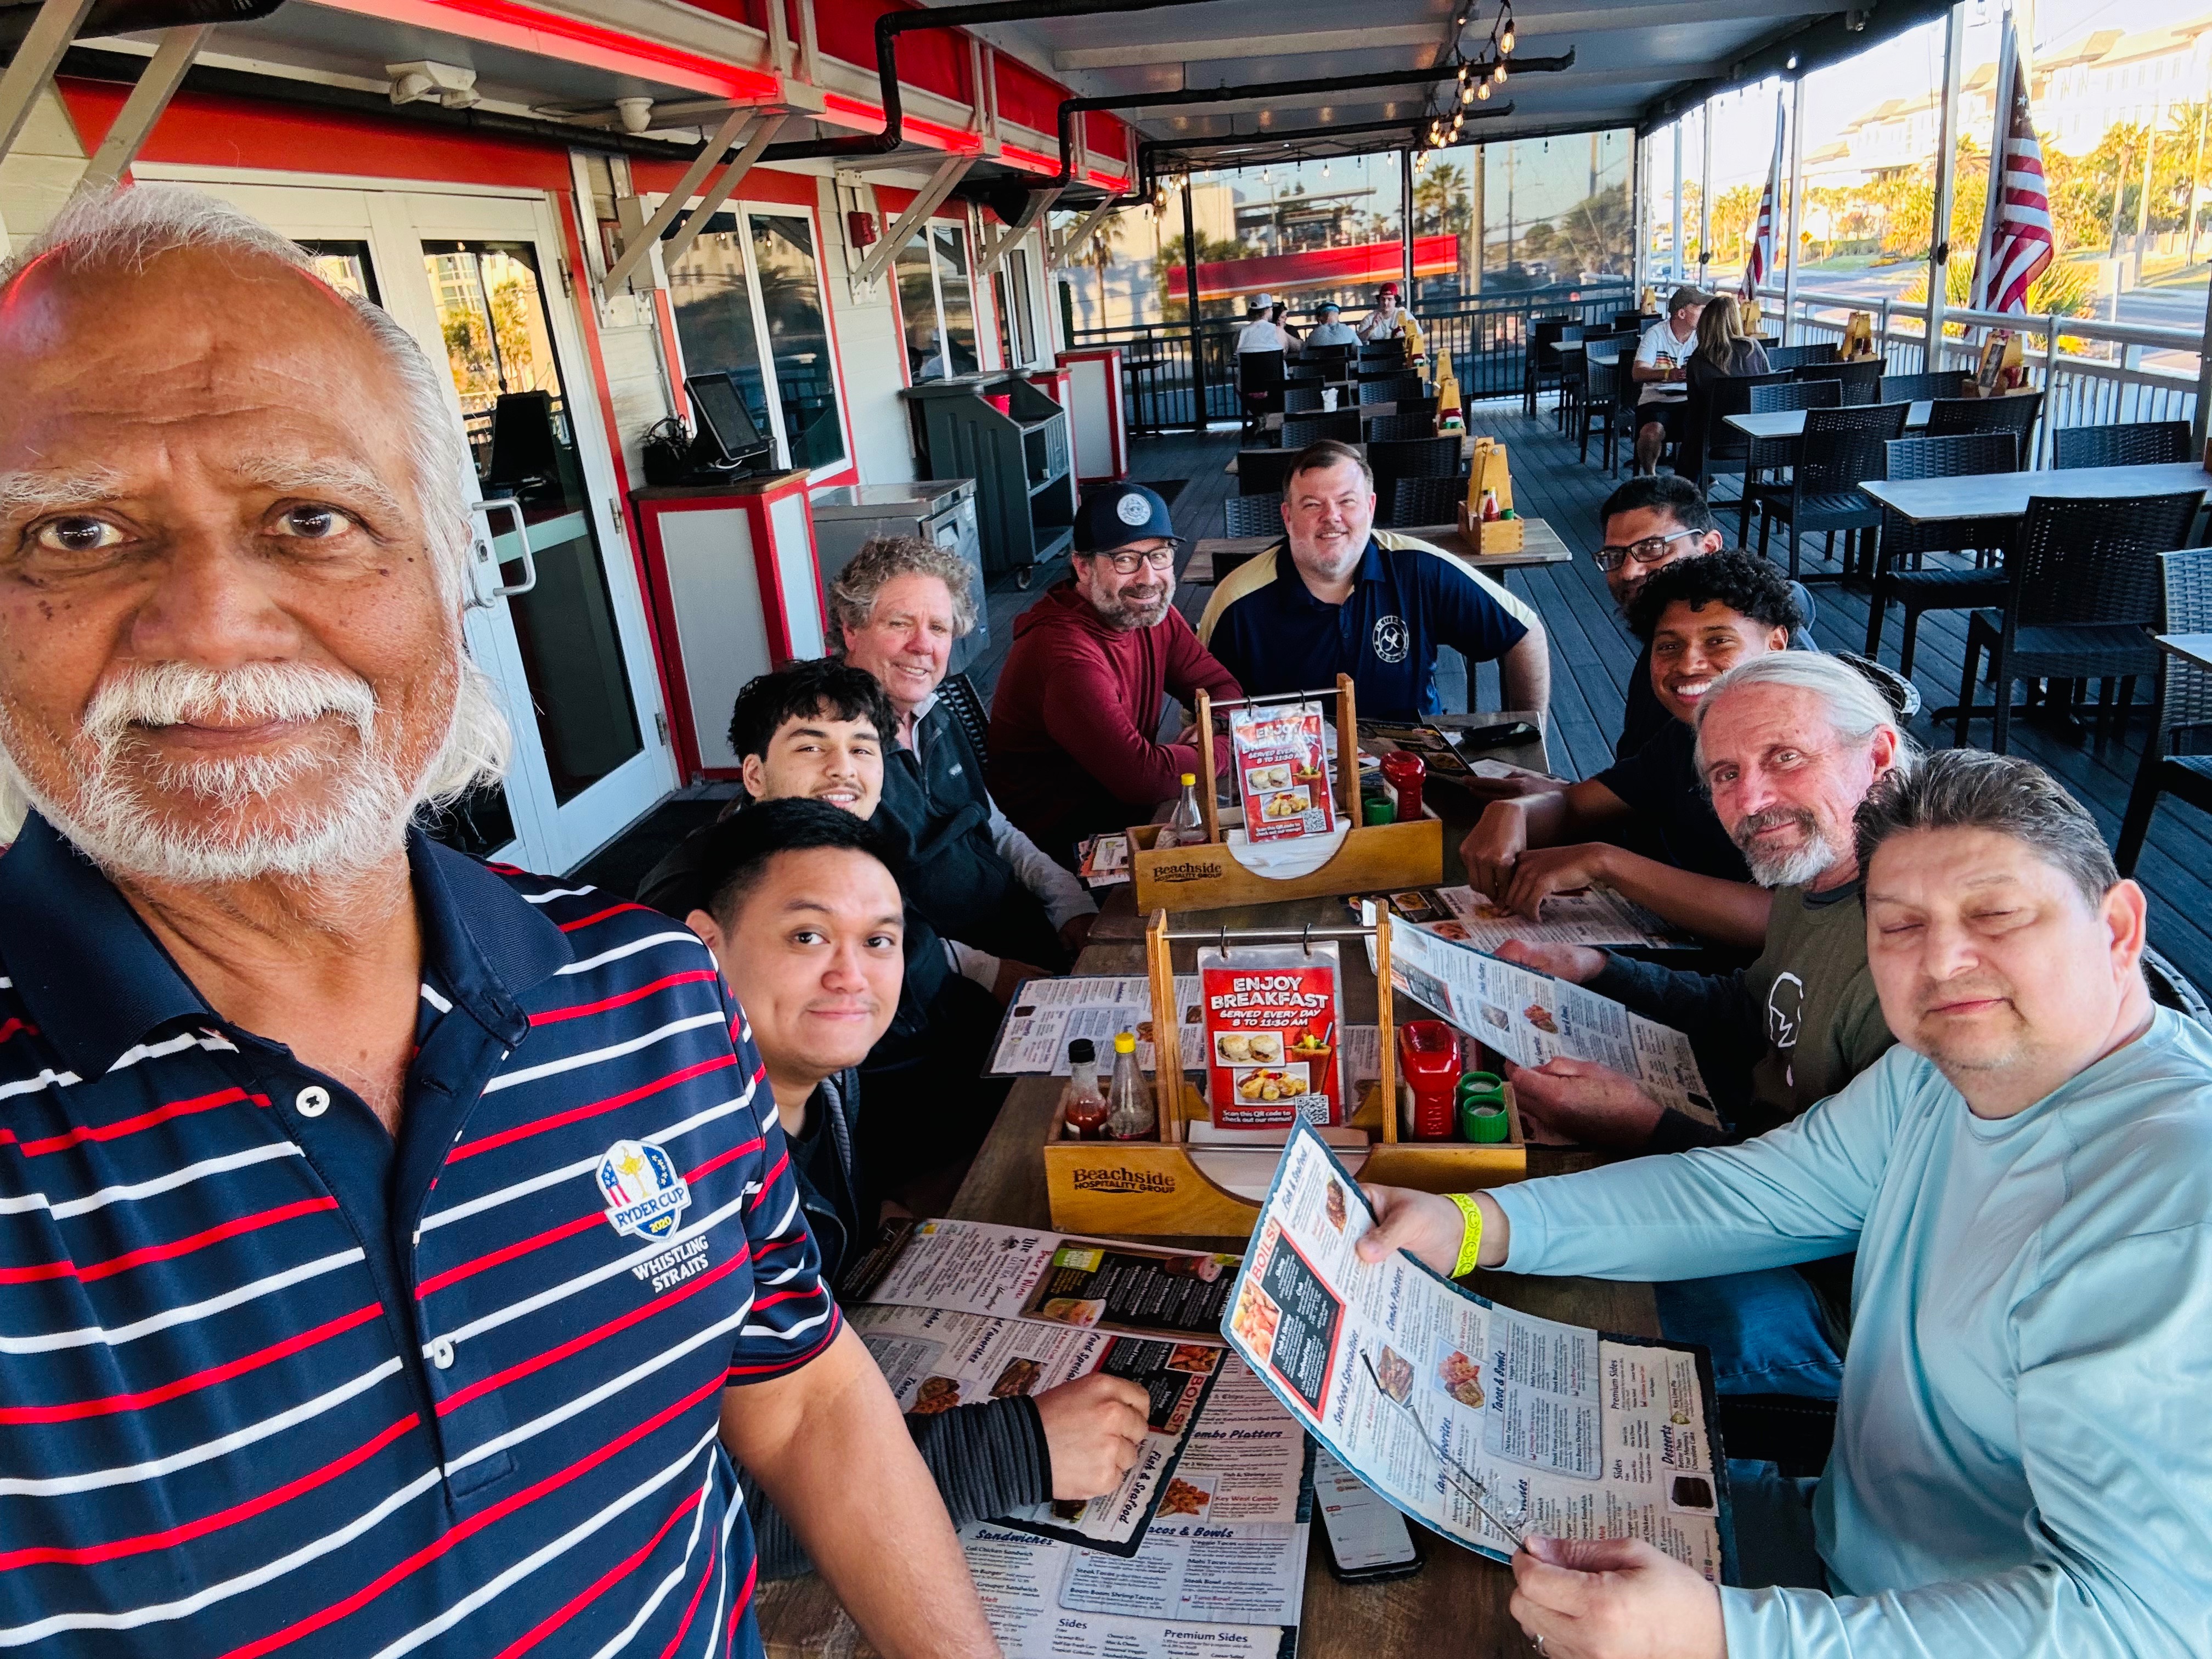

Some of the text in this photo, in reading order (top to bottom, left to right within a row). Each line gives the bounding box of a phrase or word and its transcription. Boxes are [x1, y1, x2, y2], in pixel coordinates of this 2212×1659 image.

[1154, 862, 1221, 877] Beachside
[1233, 977, 1303, 992] ENJOY
[1211, 992, 1329, 1010] BREAKFAST
[1220, 1009, 1321, 1019] SERVED EVERY DAY
[1073, 1167, 1176, 1186] Beachside
[1074, 1180, 1176, 1194] HOSPITALITY GROUP
[1281, 1187, 1293, 1210] Fish
[1291, 1144, 1307, 1182] Seafood
[615, 1188, 685, 1228] RYDER CUP
[650, 1217, 673, 1233] 2020
[631, 1235, 709, 1282] WHISTLING
[1034, 1250, 1053, 1268] Beer
[1252, 1221, 1278, 1282] BOILS!
[652, 1254, 709, 1293] STRAITS
[1386, 1266, 1404, 1331] Combo Platters
[968, 1327, 999, 1363] Favorites
[1334, 1329, 1359, 1426] Seafood Specialties
[1492, 1350, 1506, 1412] Tacos & Bowls
[1609, 1359, 1620, 1410] Premium Sides
[894, 1377, 917, 1400] Tacos
[1172, 1376, 1204, 1427] BOILS!
[1192, 1430, 1283, 1438] ombo Platters
[1662, 1424, 1674, 1465] Desserts
[1145, 1451, 1161, 1470] Fish
[1613, 1459, 1623, 1480] Sides
[1119, 1482, 1146, 1524] Seafood
[975, 1529, 1054, 1545] Sandwiches
[1147, 1526, 1234, 1538] acos & Bowls
[1058, 1618, 1087, 1629] Sides
[1164, 1629, 1248, 1643] Premium Sides
